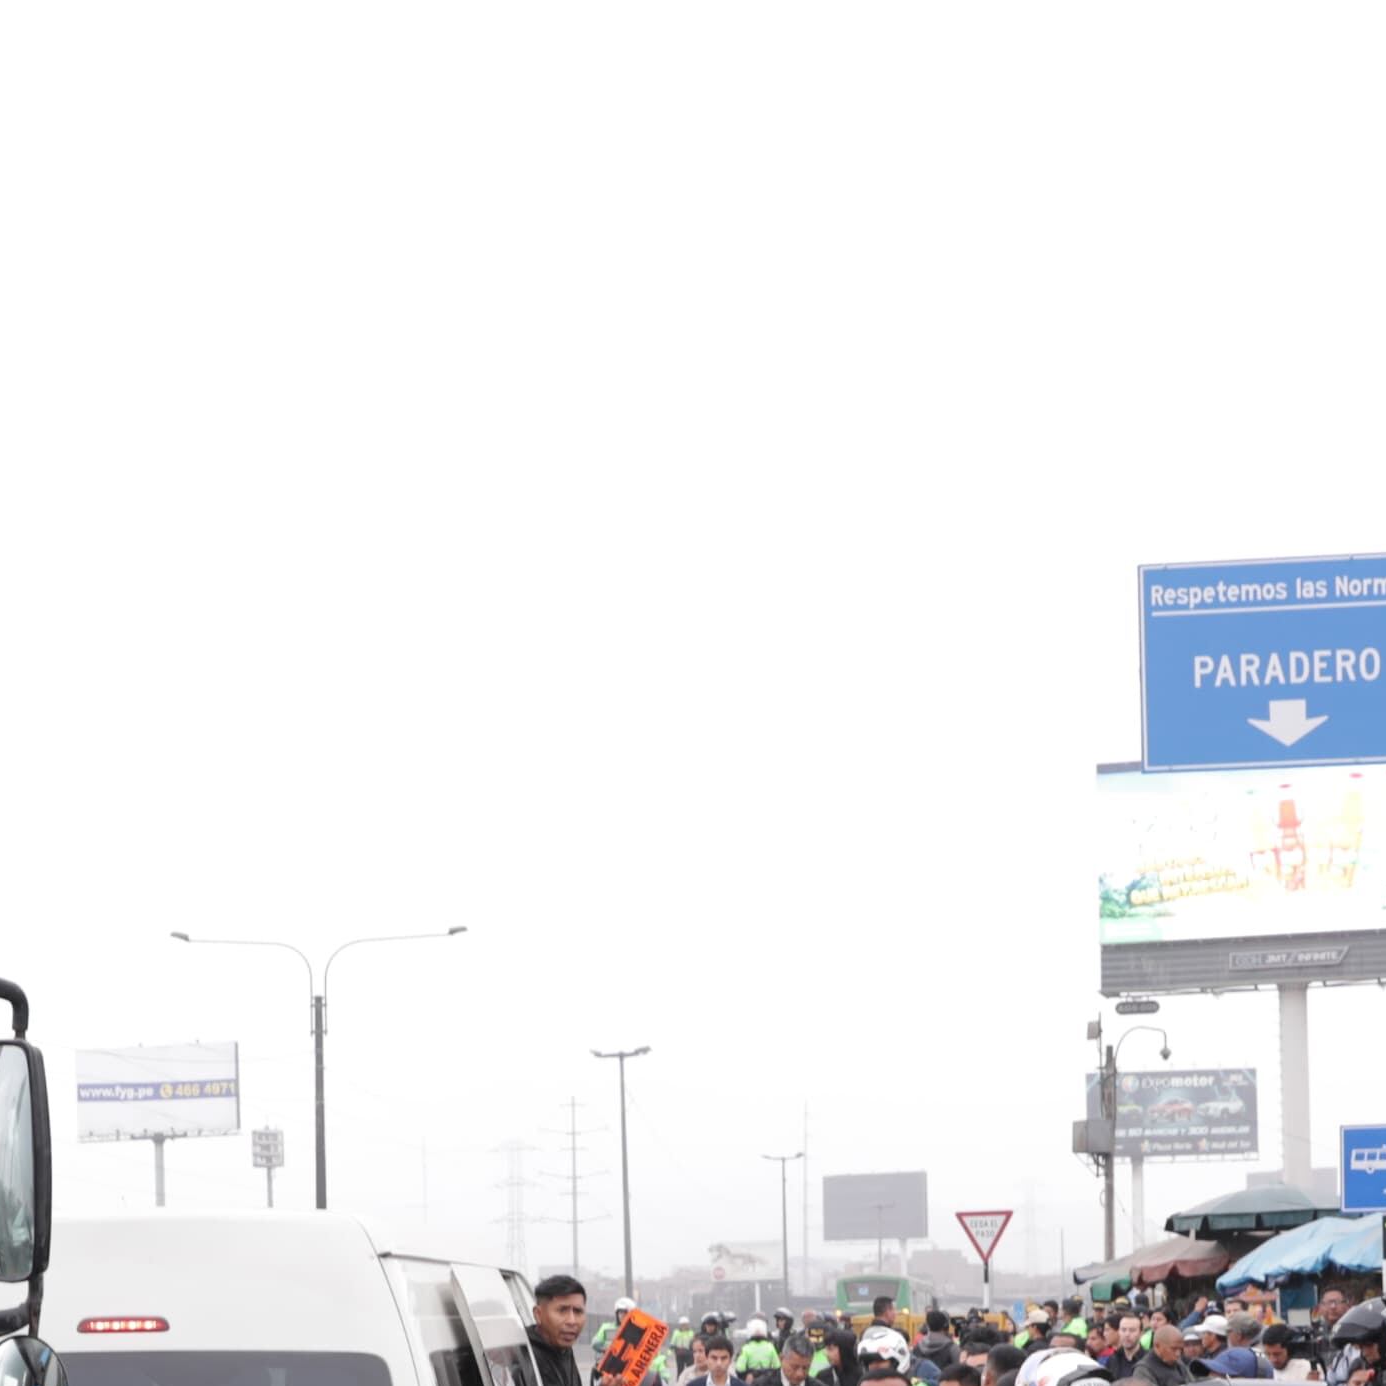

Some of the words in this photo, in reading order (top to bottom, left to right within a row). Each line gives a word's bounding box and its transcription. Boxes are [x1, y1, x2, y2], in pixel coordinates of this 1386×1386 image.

[1150, 581, 1288, 609] Respetemos
[1296, 577, 1328, 600] las
[1193, 646, 1381, 690] PARADERO
[631, 1323, 668, 1380] ARENERA
